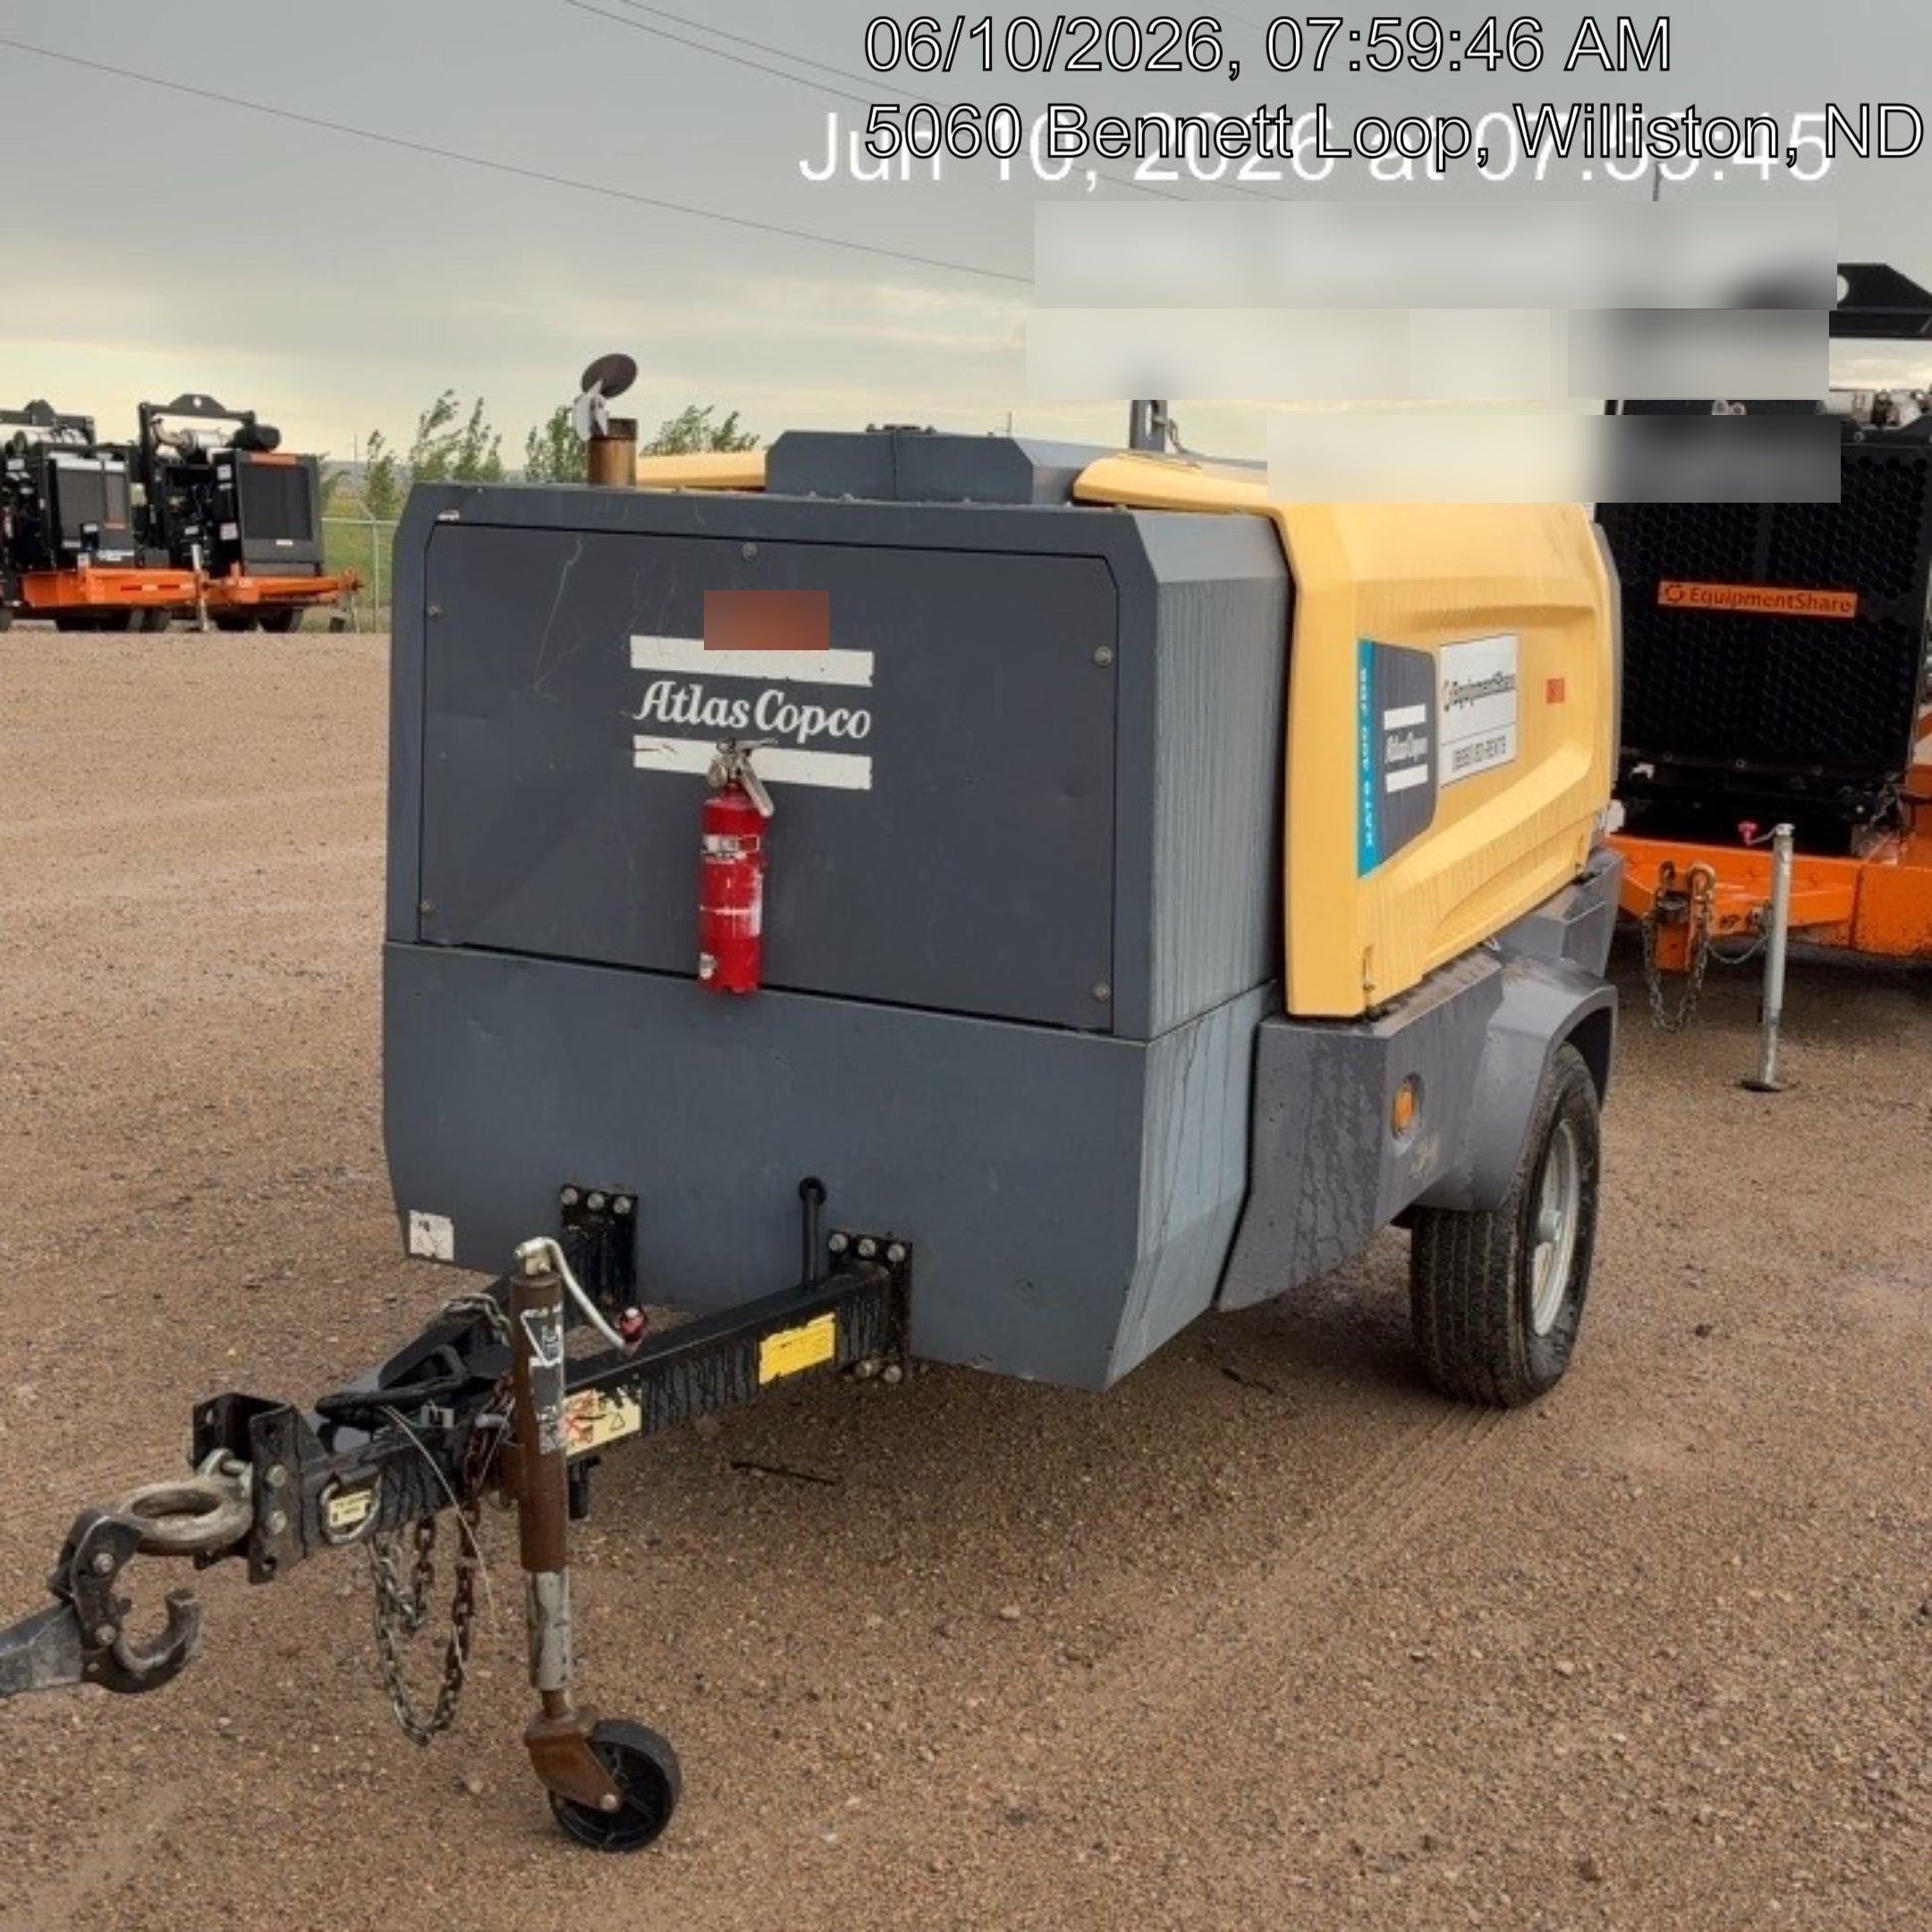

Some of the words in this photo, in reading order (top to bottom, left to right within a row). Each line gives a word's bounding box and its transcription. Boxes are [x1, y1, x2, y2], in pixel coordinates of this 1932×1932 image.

[1689, 586, 1852, 613] EquipmentShare
[633, 680, 750, 728] Atlas
[753, 689, 871, 743] Copco
